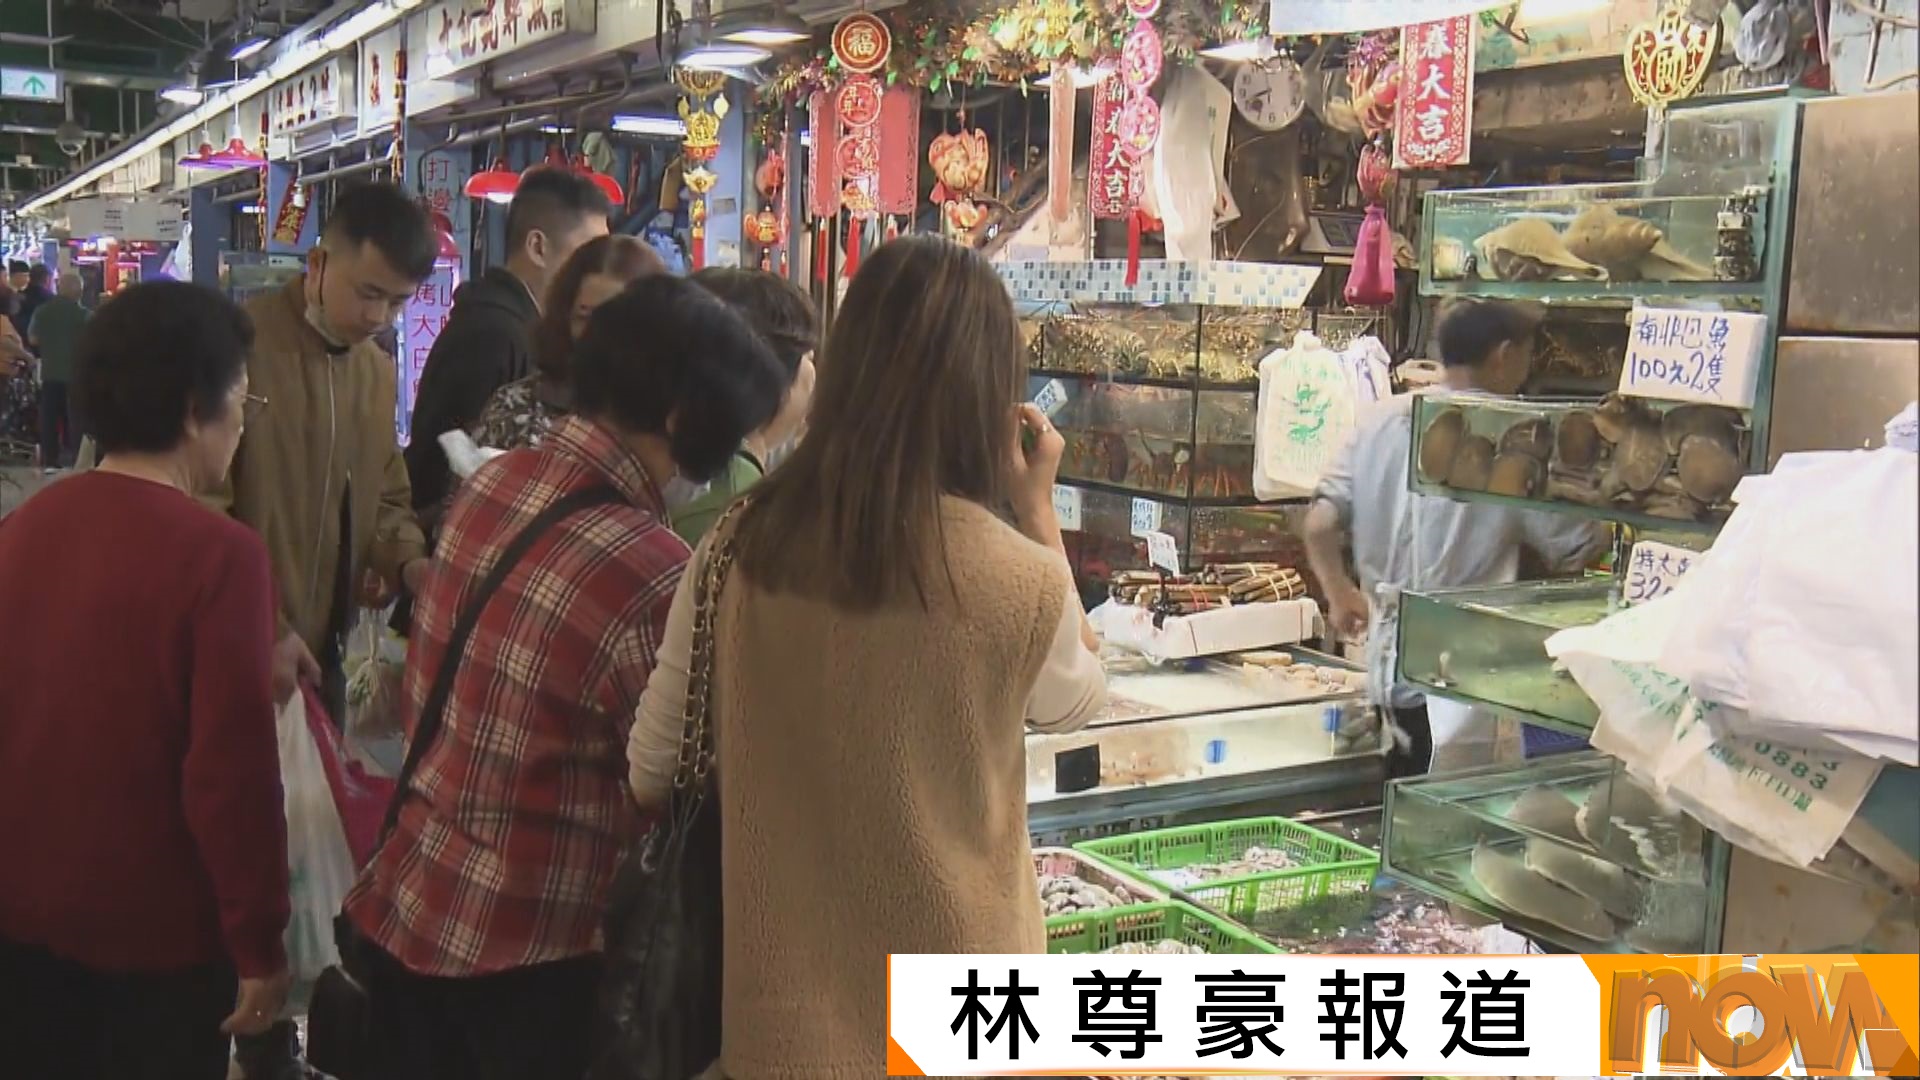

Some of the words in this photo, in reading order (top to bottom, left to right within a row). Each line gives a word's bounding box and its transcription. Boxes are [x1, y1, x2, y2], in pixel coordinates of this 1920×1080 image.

[848, 28, 876, 57] 福
[1416, 24, 1453, 141] 春大吉
[1630, 572, 1674, 601] 32
